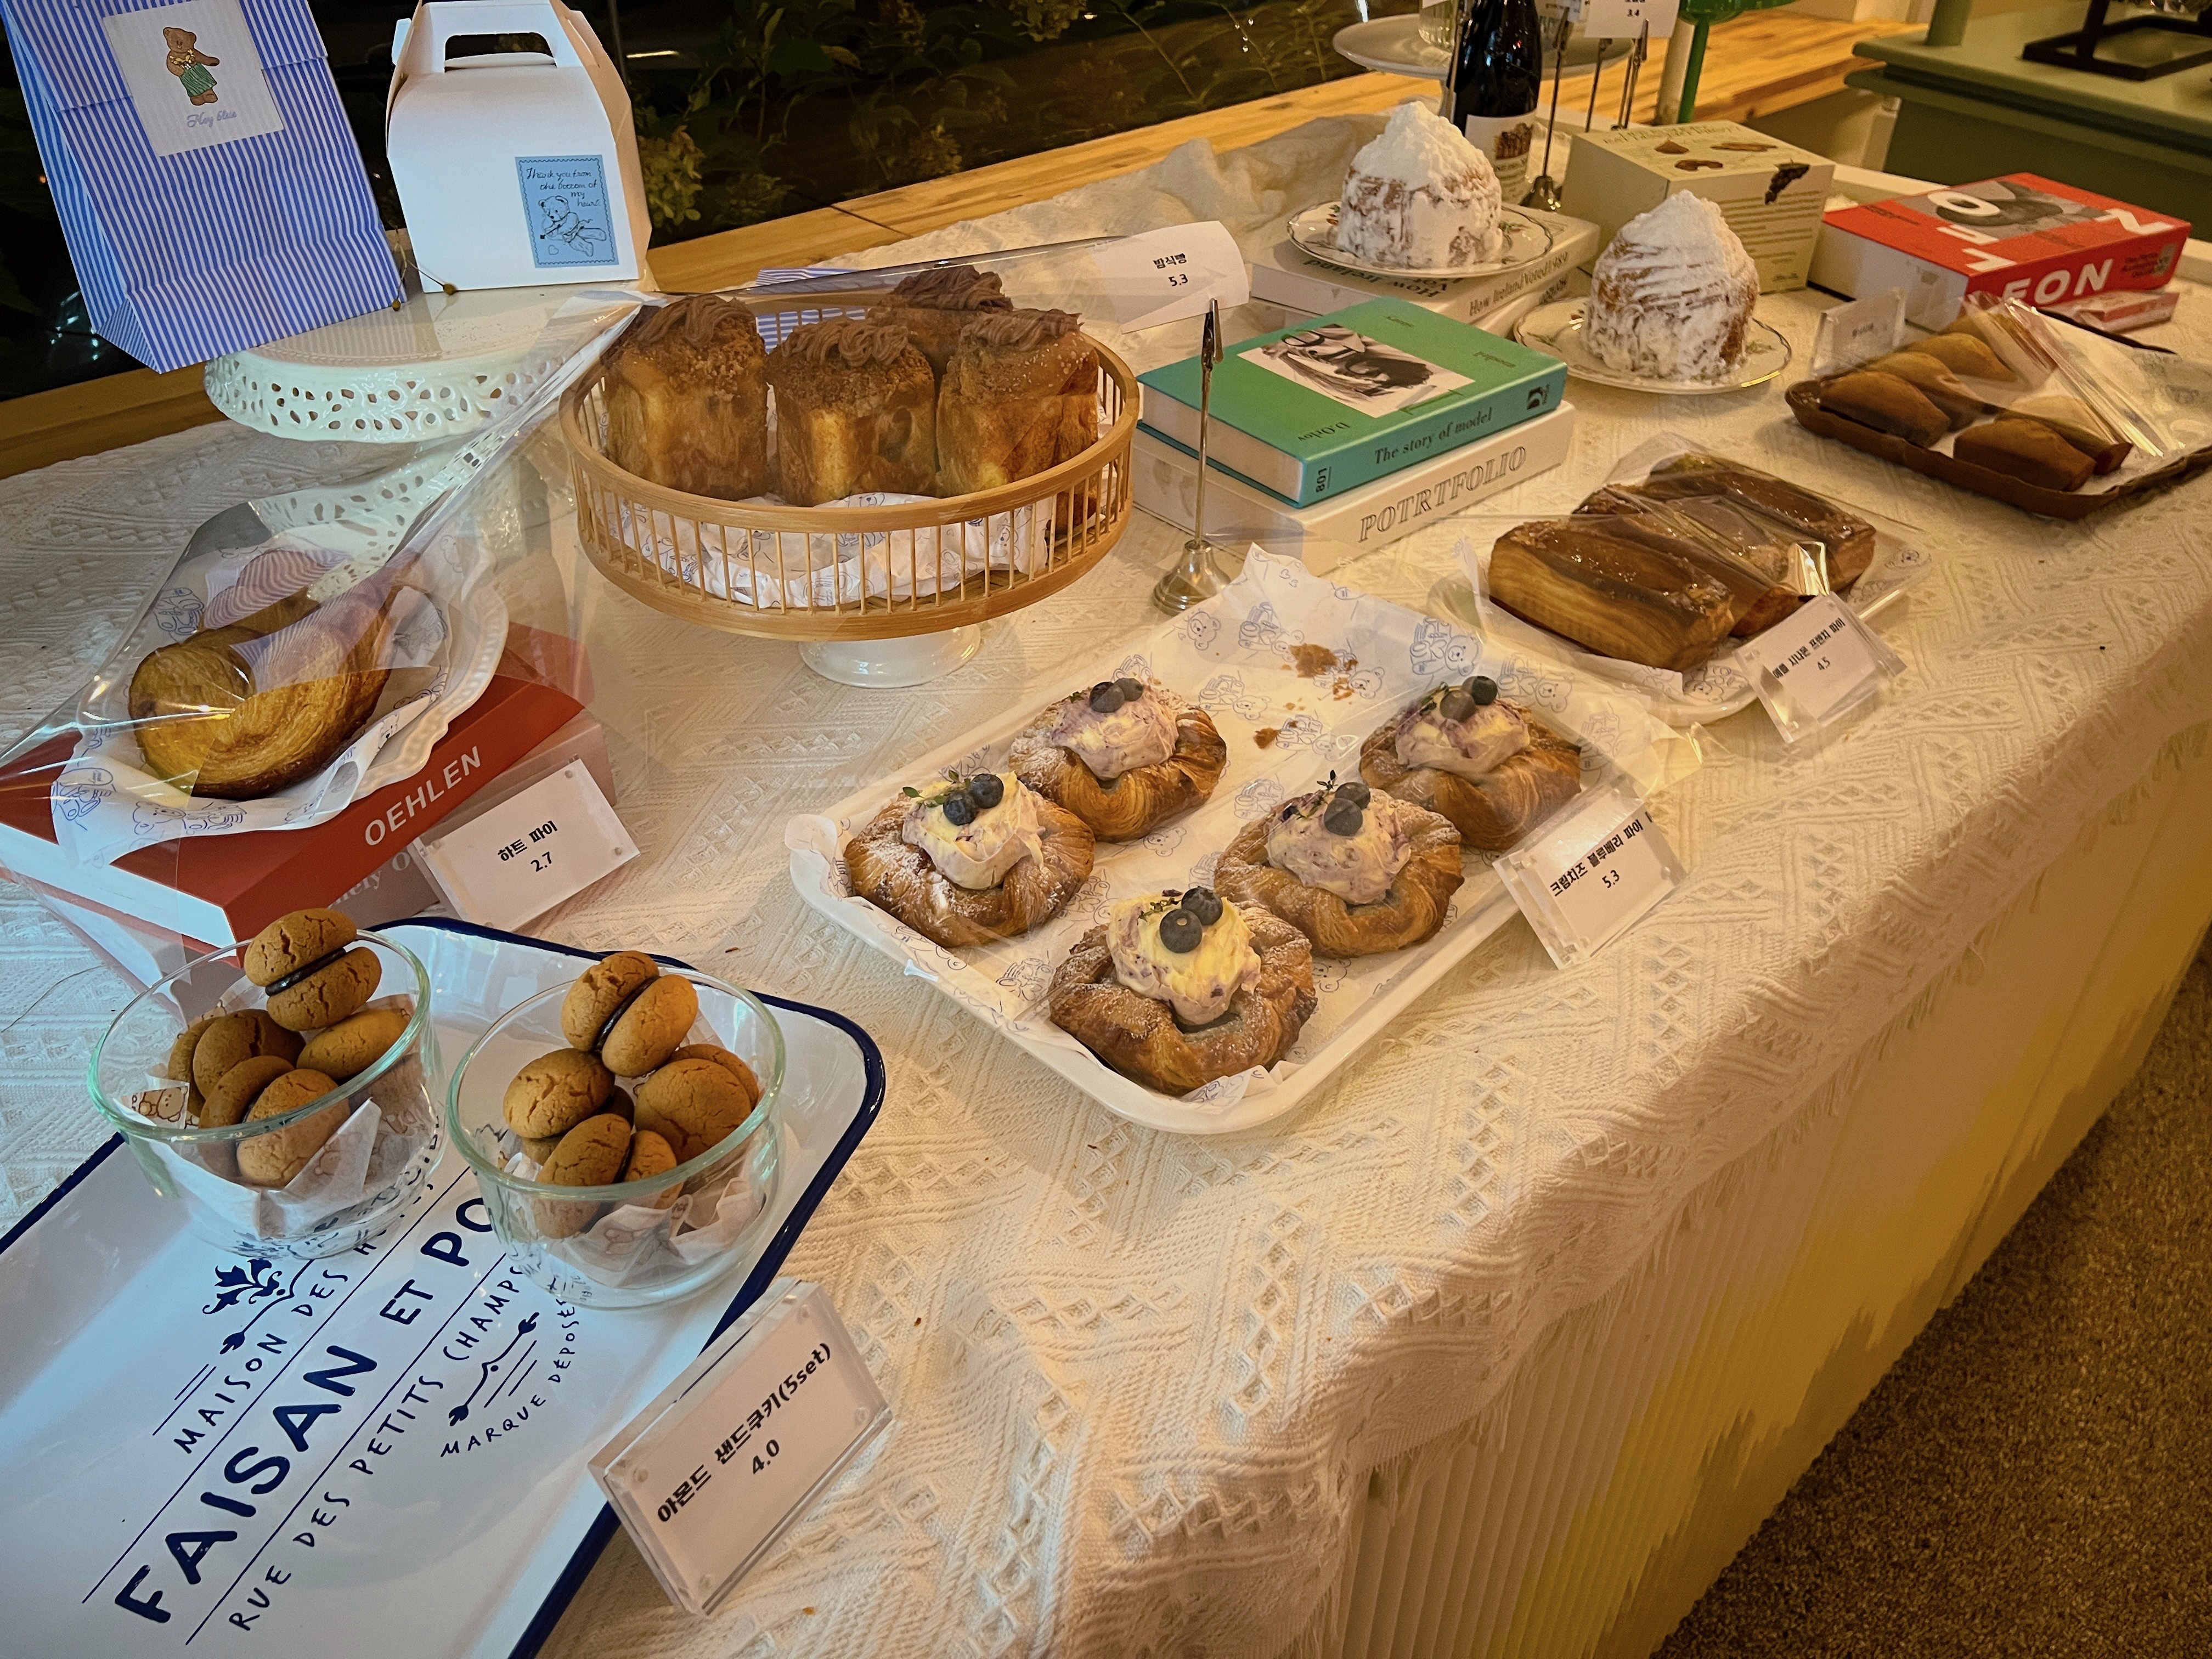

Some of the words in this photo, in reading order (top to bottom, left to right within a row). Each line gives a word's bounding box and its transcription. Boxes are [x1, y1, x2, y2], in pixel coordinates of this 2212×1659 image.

[526, 167, 555, 180] Thank
[555, 172, 571, 182] you
[572, 169, 591, 178] from
[540, 182, 556, 190] the
[557, 179, 586, 190] bottom
[588, 179, 597, 188] of
[571, 191, 585, 200] my
[1153, 253, 1187, 269] 밤식빵
[1168, 273, 1188, 286] 5.3
[1375, 447, 1399, 464] The
[1403, 433, 1433, 453] story
[1438, 421, 1454, 438] of
[1455, 407, 1492, 433] model
[1316, 467, 1327, 493] 801
[1359, 446, 1527, 543] POTRTFOLIO
[365, 745, 481, 845] OEHLEN
[498, 839, 528, 862] 하트
[528, 820, 558, 843] 파이
[530, 851, 553, 872] 2.7
[1550, 862, 1588, 897] 크림치즈
[1587, 833, 1624, 868] 블루베리
[1623, 819, 1644, 839] 파이
[1601, 870, 1620, 889] 5.3
[173, 1333, 288, 1454] MAISON
[291, 1269, 349, 1317] DES
[439, 1394, 546, 1458] MARQUE
[657, 1464, 712, 1522] 아몬드
[714, 1342, 831, 1465] 샌드쿠키(5set)
[114, 1345, 378, 1623] FAISAN
[379, 1278, 434, 1325] ET
[753, 1439, 780, 1475] 4.0
[229, 1565, 292, 1631] RUE
[292, 1491, 350, 1548] DES
[348, 1375, 444, 1475] PETITS
